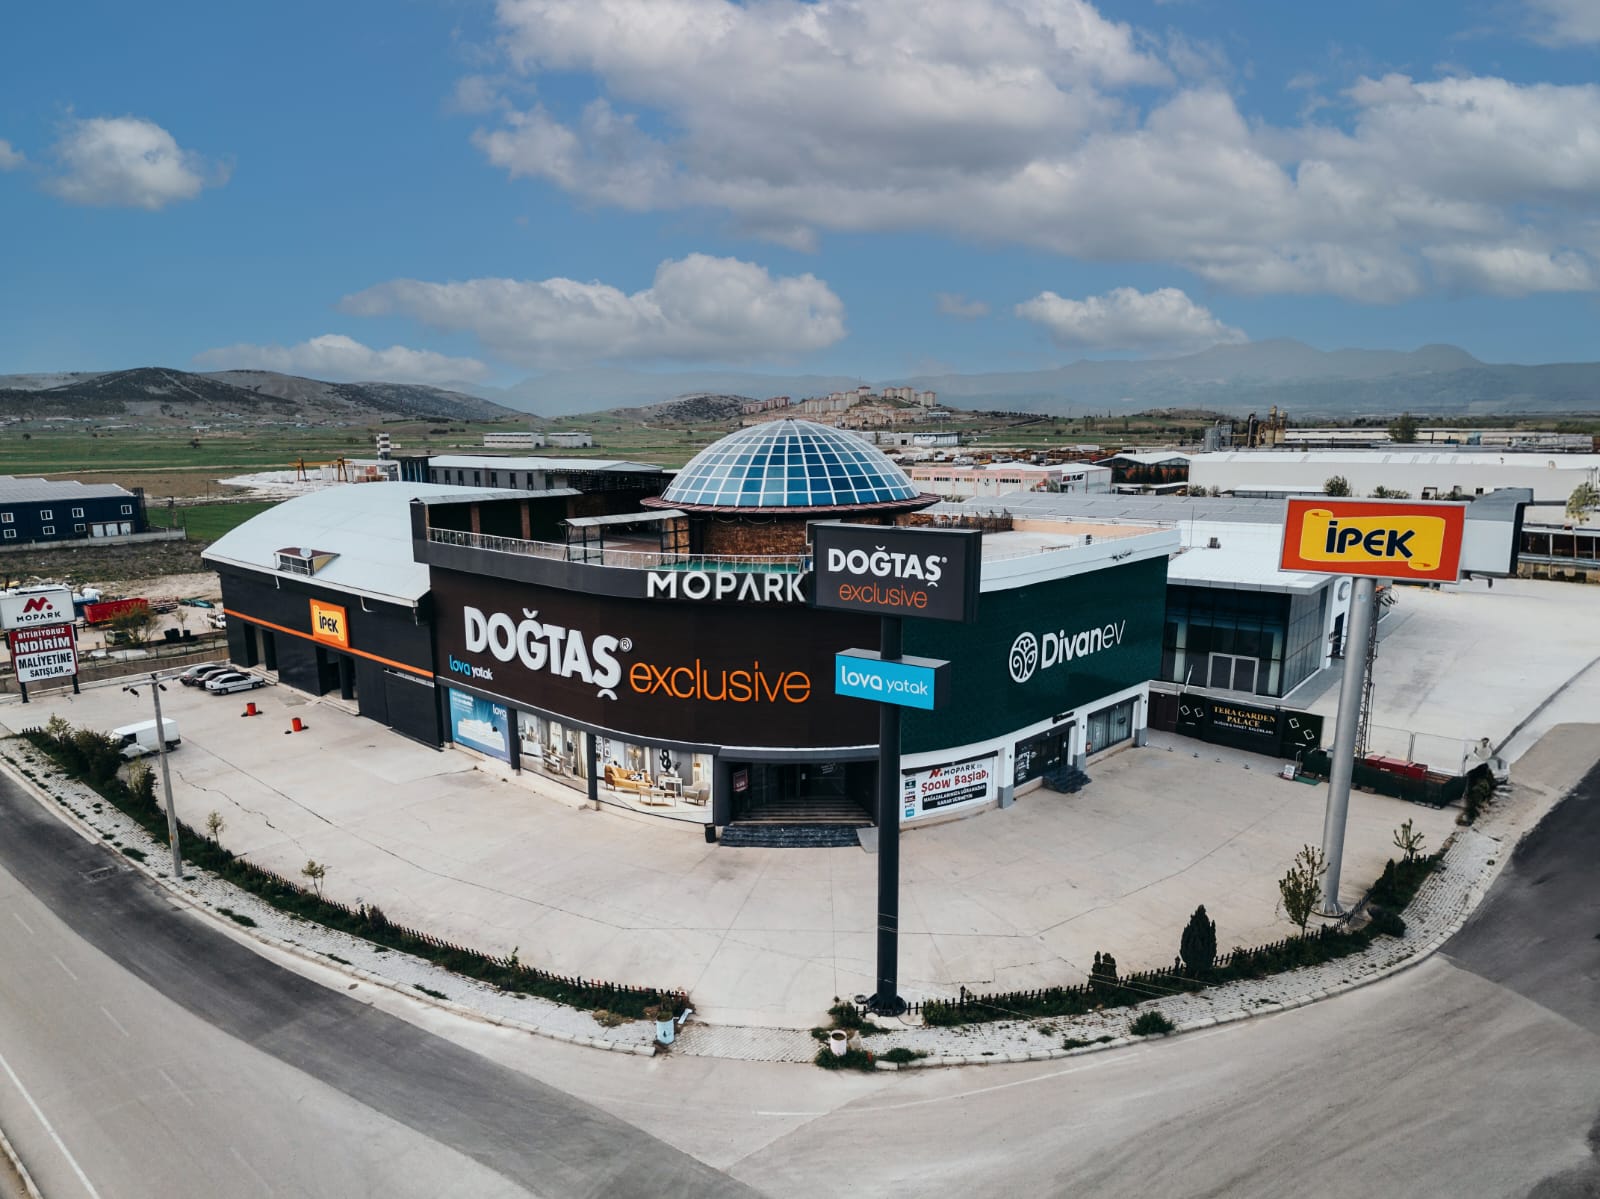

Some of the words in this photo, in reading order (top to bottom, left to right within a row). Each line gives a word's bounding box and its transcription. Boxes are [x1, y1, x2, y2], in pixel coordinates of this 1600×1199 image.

[1325, 520, 1415, 558] İPEK
[647, 571, 806, 601] MOPARK
[839, 582, 928, 609] exclusive
[16, 611, 61, 622] MOPARK
[14, 636, 71, 654] İNDİRİM
[1041, 619, 1126, 669] Divanev
[18, 652, 73, 670] MALİYETİNE
[30, 665, 64, 677] SATIŞLAR
[449, 655, 471, 676] lova
[472, 666, 493, 680] yatak
[629, 659, 811, 704] exclusive
[841, 665, 883, 691] lova
[886, 679, 928, 696] yatak
[1214, 706, 1237, 716] TERA
[1238, 710, 1275, 722] GARDEN
[1227, 716, 1260, 727] PALACE
[943, 764, 976, 776] MOPARK
